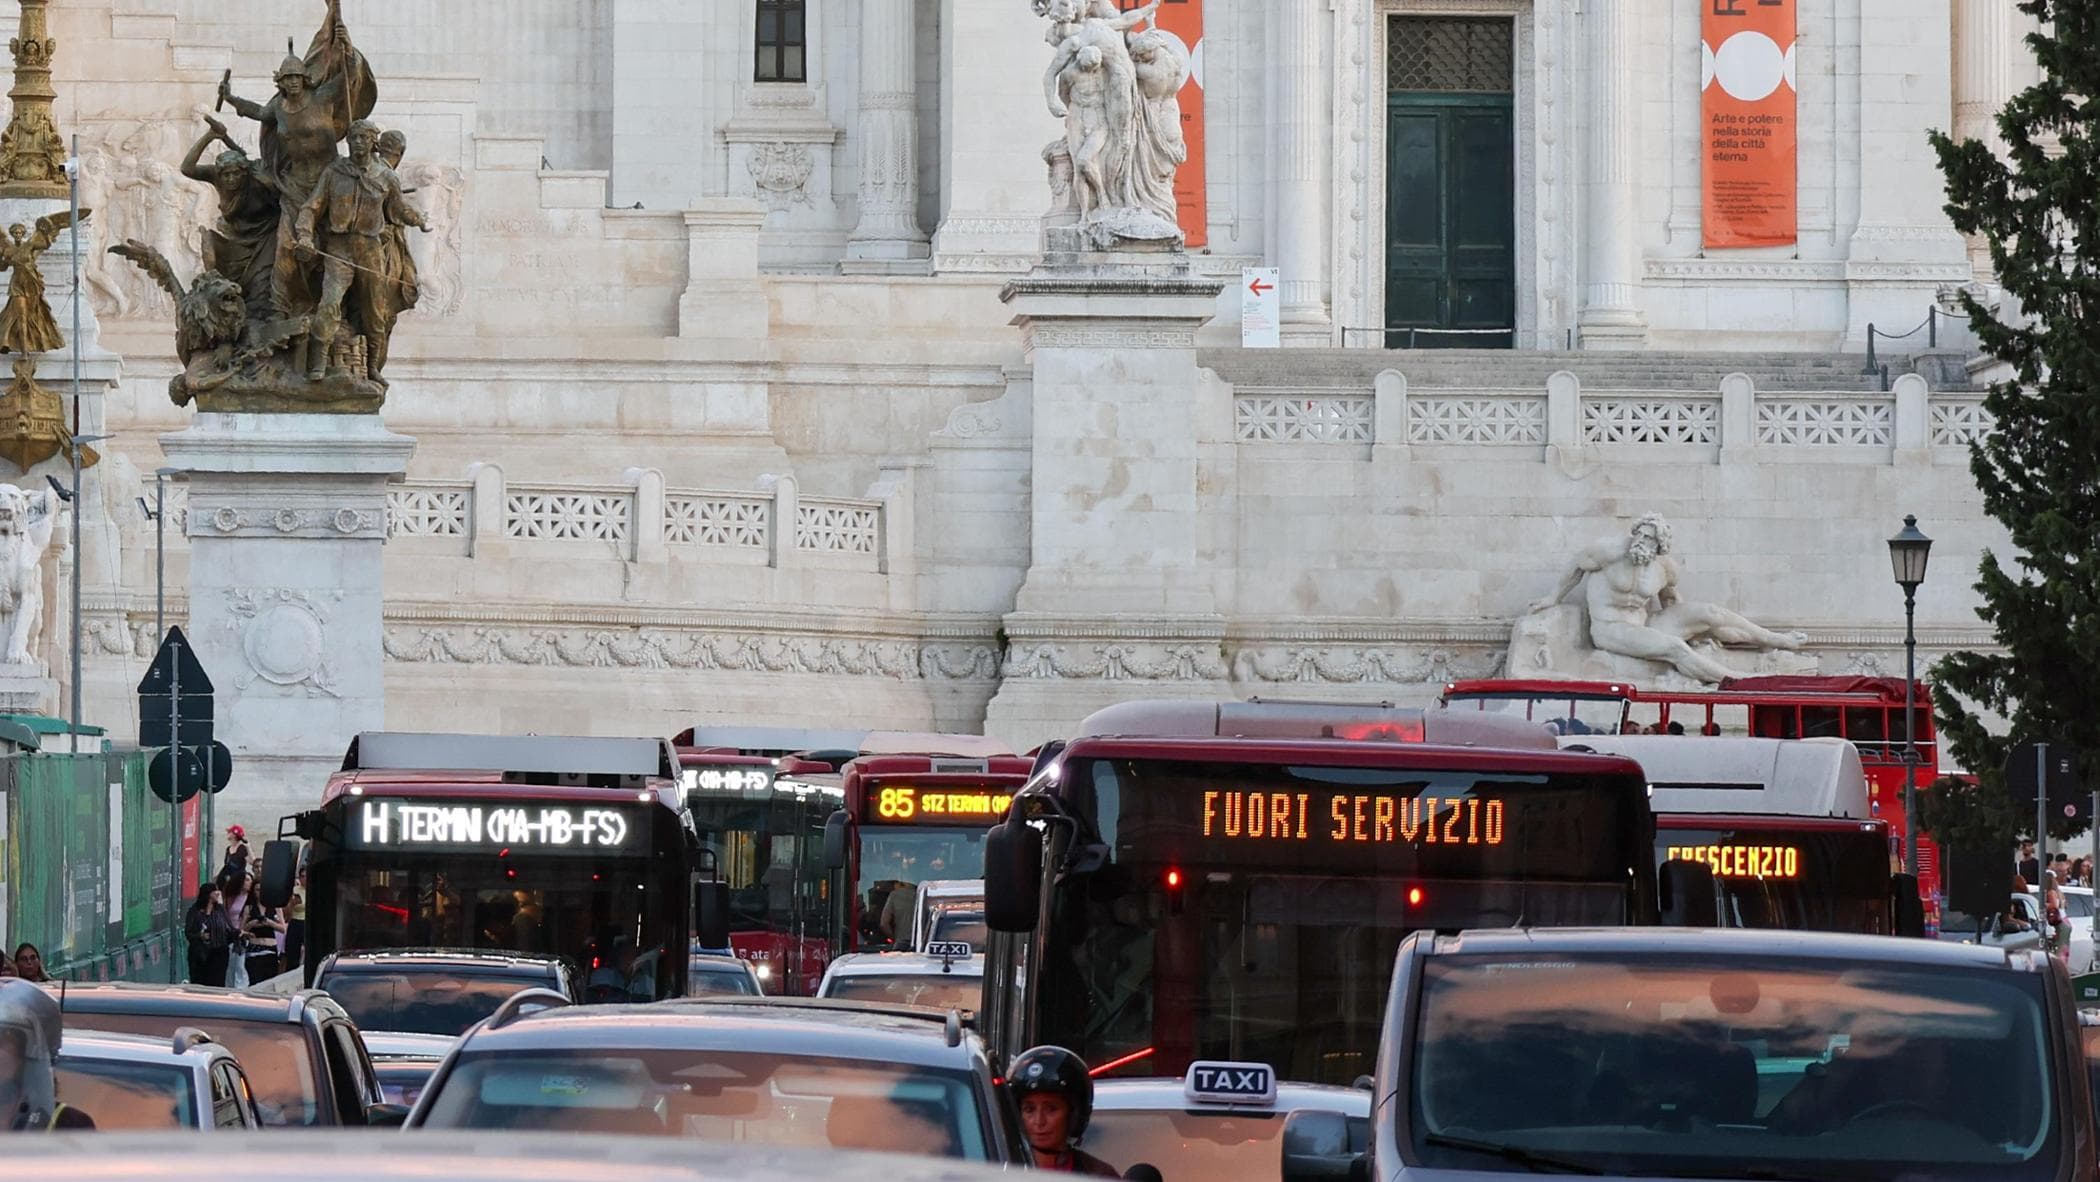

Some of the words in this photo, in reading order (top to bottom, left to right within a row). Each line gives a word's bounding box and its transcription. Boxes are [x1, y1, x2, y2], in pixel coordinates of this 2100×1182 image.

[1712, 113, 1737, 124] Arte
[1738, 115, 1746, 124] e
[1747, 113, 1784, 125] potere
[1712, 126, 1739, 137] nella
[1741, 126, 1772, 137] storia
[1712, 138, 1739, 149] della
[1741, 138, 1766, 149] città
[1712, 151, 1748, 162] eterna
[879, 787, 915, 818] 85
[921, 794, 945, 813] STZ
[362, 801, 389, 844] H
[1203, 791, 1308, 839] FUORI
[1330, 795, 1504, 845] SERVIZIO
[929, 944, 966, 954] TAXI
[1195, 1069, 1265, 1091] TAXI
